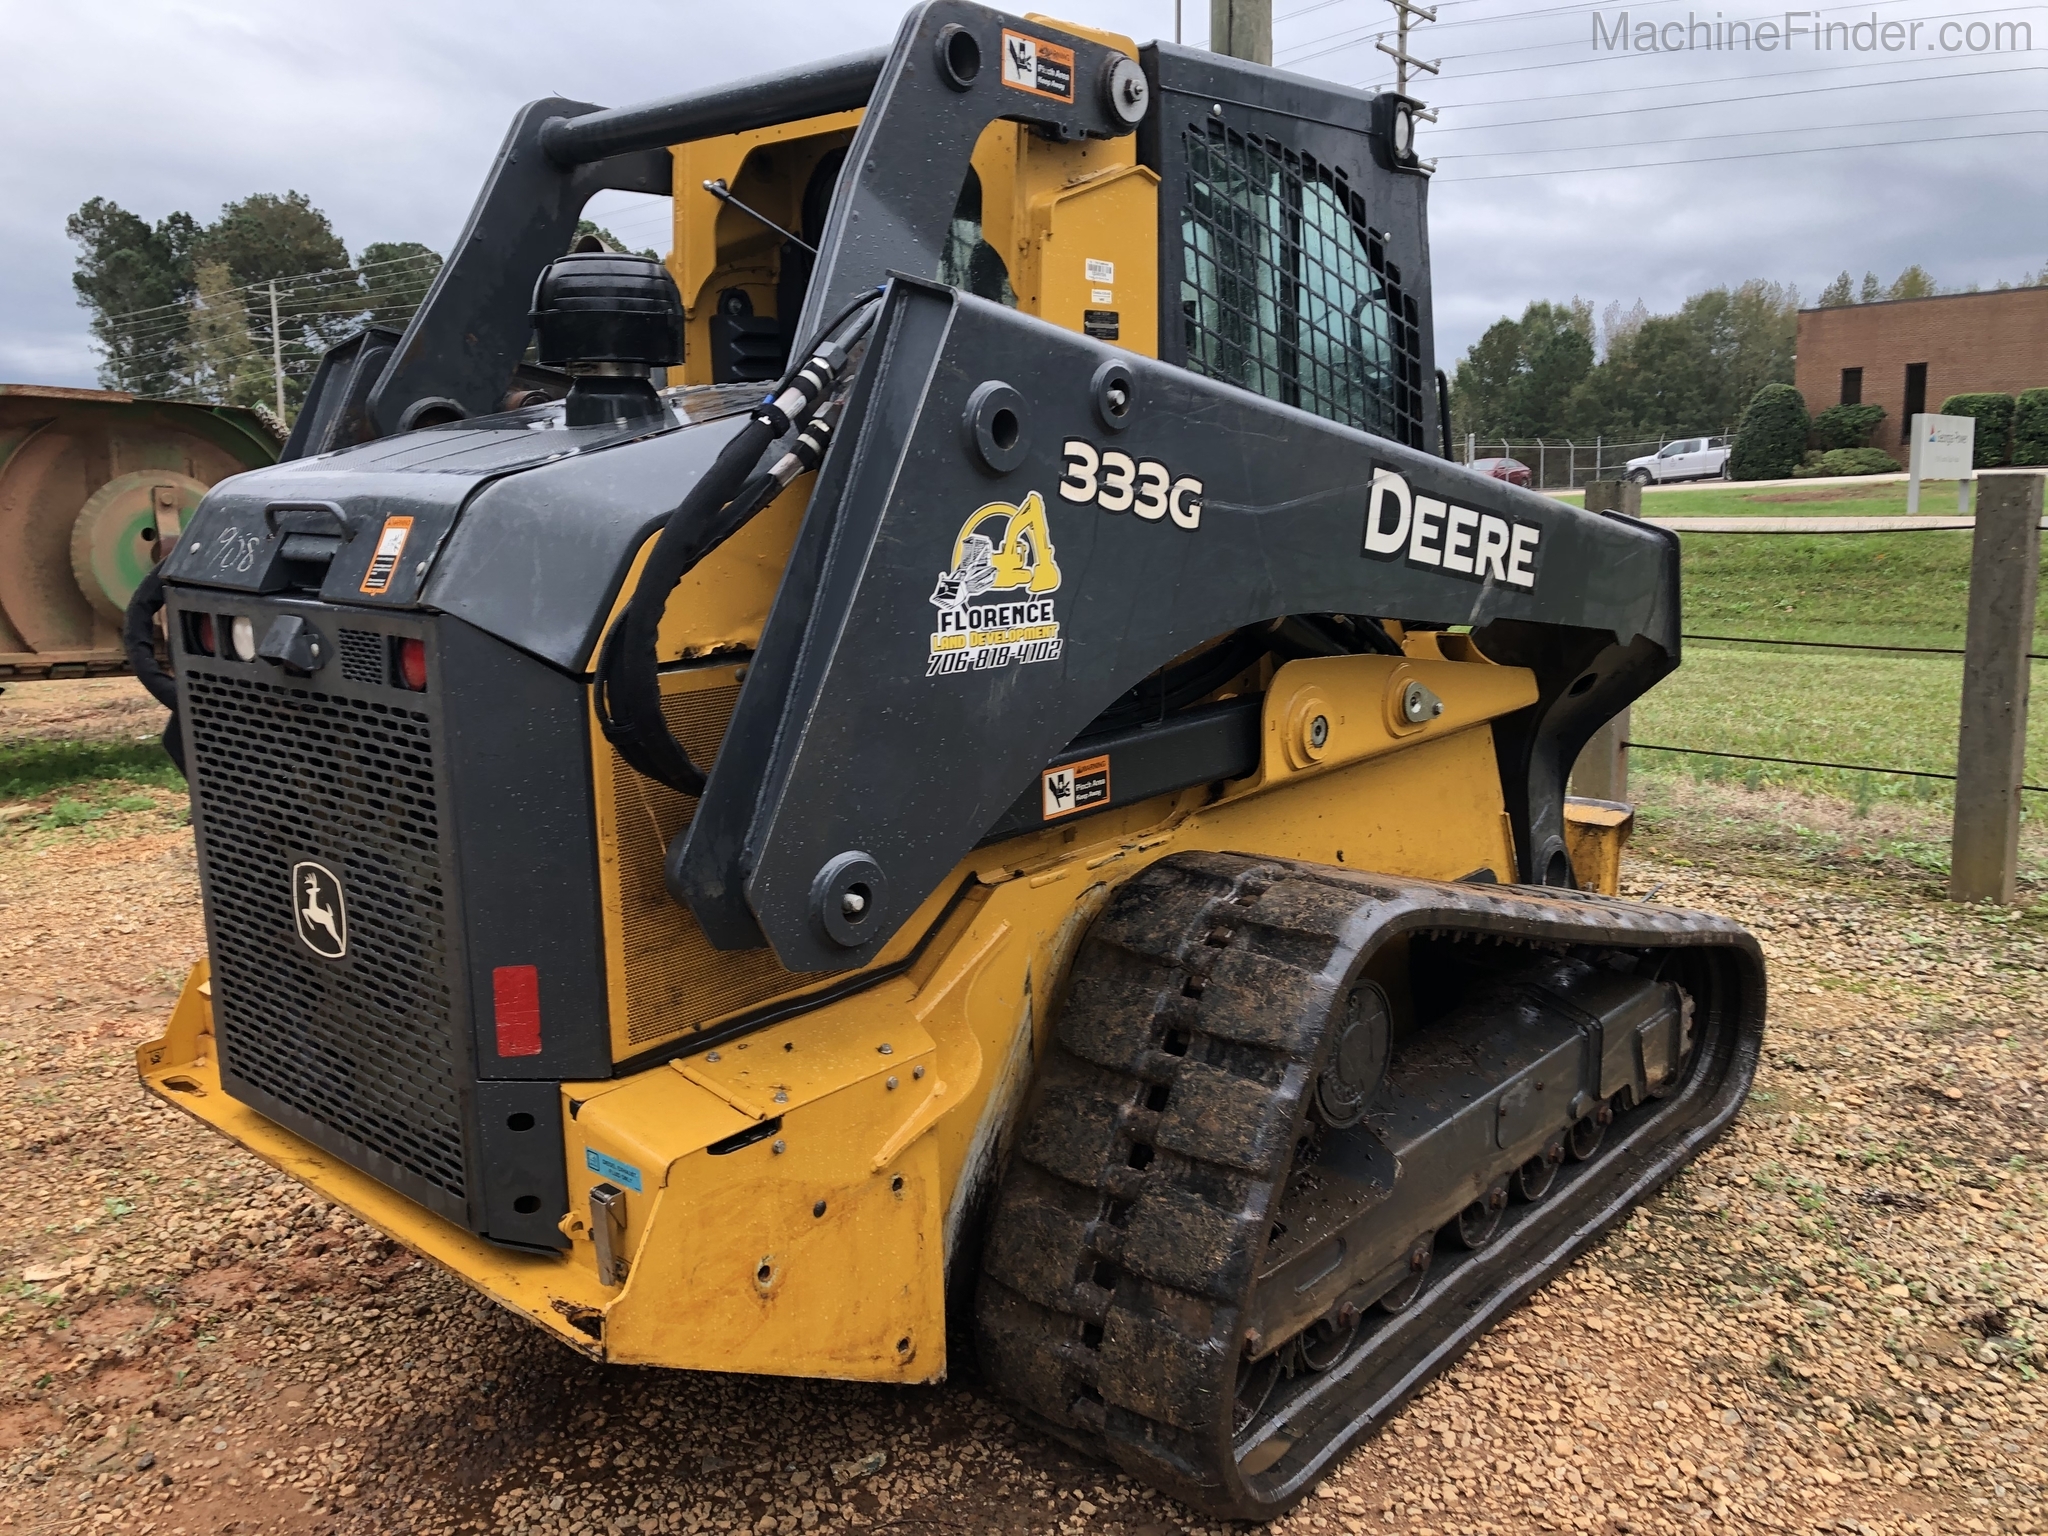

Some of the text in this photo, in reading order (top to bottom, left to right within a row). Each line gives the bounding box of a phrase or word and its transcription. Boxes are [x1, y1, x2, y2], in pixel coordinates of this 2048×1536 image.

[1059, 441, 1203, 529] 333G
[1364, 467, 1541, 588] DEERE
[941, 602, 1051, 632] FLORENCE
[933, 624, 1057, 651] LAND DEVELOPMENT
[926, 641, 1062, 676] 706-818-4102
[1075, 781, 1092, 791] Pinch
